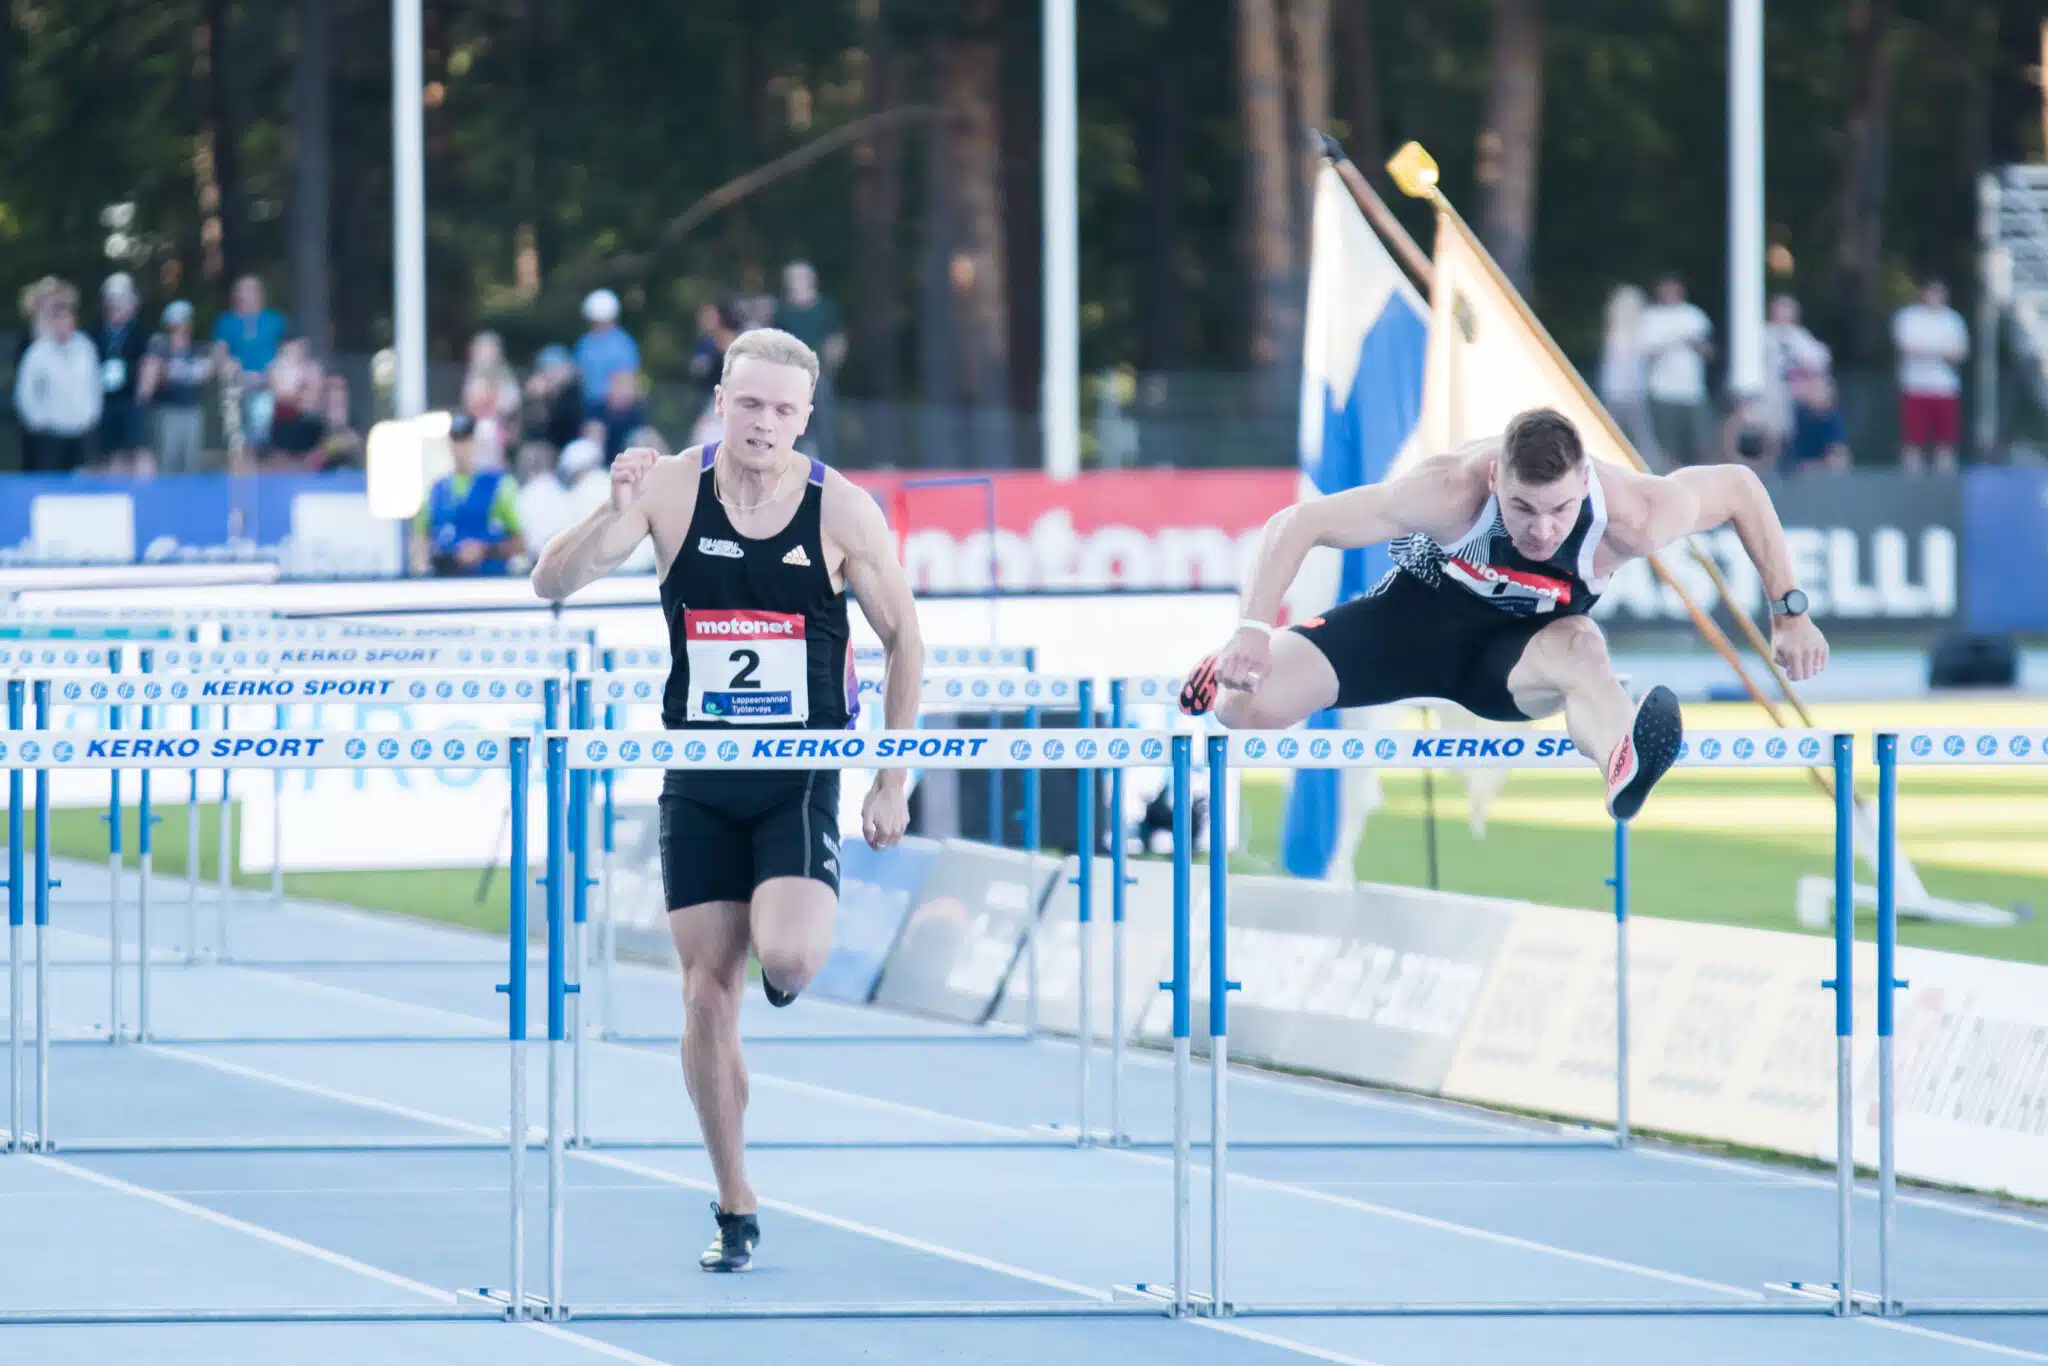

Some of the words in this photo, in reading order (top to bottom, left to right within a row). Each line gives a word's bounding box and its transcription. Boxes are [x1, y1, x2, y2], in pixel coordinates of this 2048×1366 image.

[695, 618, 793, 634] motonet
[281, 649, 357, 661] KERKO
[365, 649, 440, 661] SPORT
[728, 649, 761, 689] 2
[202, 680, 295, 696] KERKO
[303, 680, 394, 696] SPORT
[732, 695, 789, 705] Lappeenrannan
[732, 704, 772, 713] Työterveys
[86, 738, 200, 757] KERKO
[211, 738, 324, 757] SPORT
[752, 738, 865, 758] KERKO
[875, 738, 988, 757] SPORT
[1412, 738, 1525, 757] KERKO
